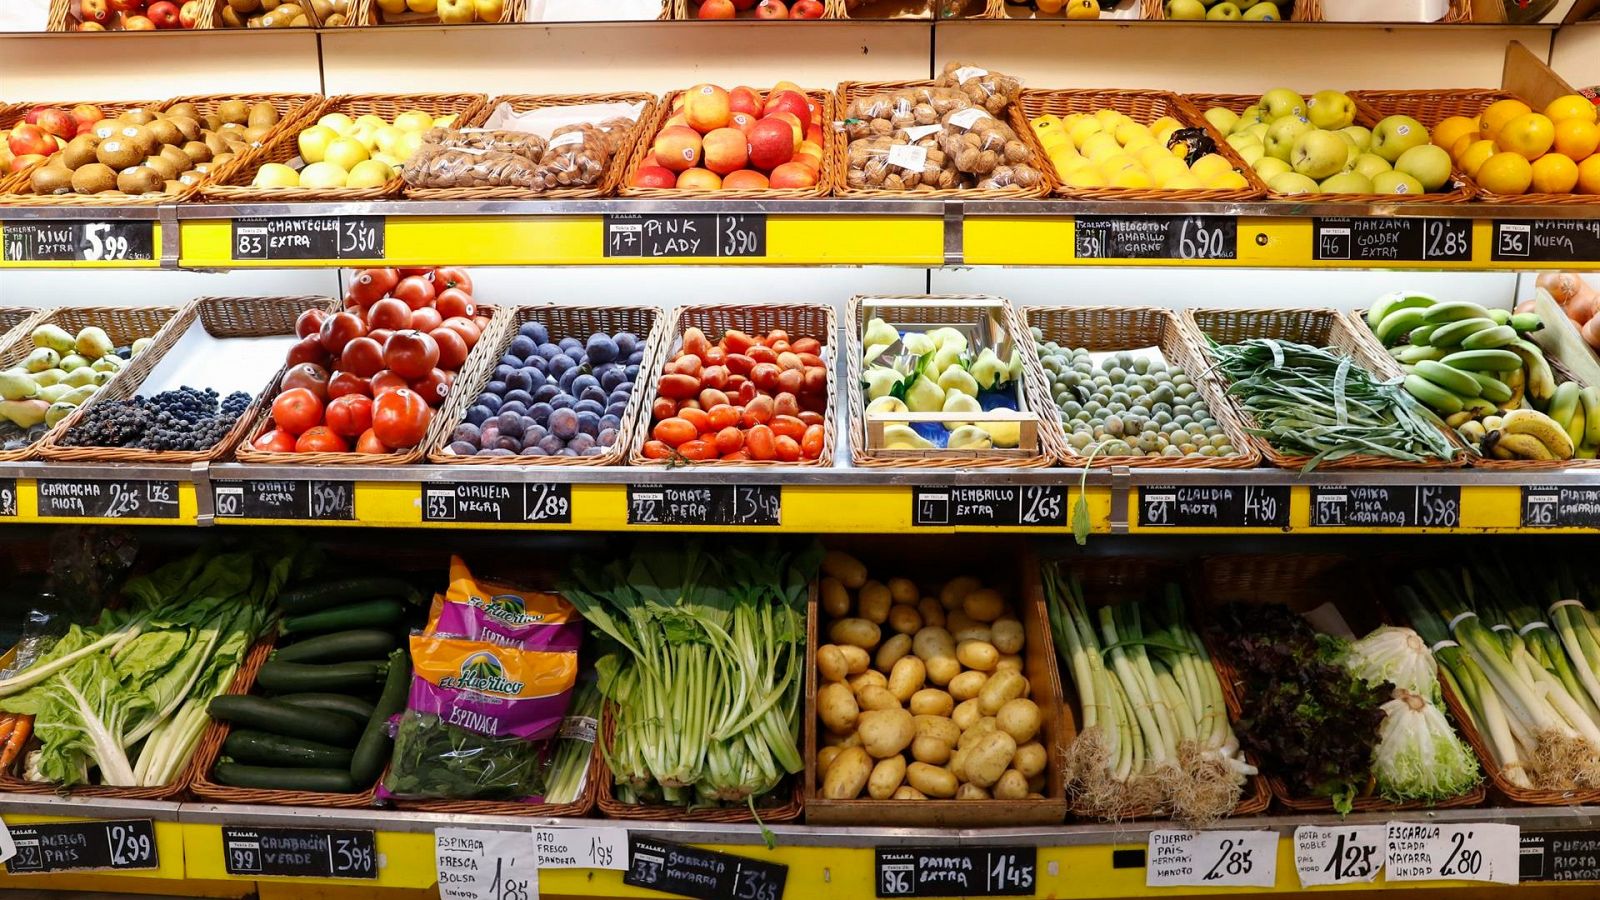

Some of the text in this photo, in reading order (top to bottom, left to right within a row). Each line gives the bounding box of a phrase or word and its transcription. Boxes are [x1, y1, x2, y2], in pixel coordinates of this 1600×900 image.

[1354, 219, 1411, 231] MANZANA
[38, 244, 74, 254] EXTRA
[239, 236, 262, 253] 83
[270, 235, 311, 248] EXTRA
[612, 232, 637, 250] 17
[653, 238, 700, 256] LADY
[1082, 237, 1099, 258] 39
[1322, 236, 1339, 255] 46
[1502, 233, 1523, 251] 36
[10, 241, 22, 260] 10
[1361, 247, 1399, 258] EXTRA
[153, 485, 169, 500] 76
[251, 481, 296, 492] TOMATE
[457, 485, 510, 499] CIRUELA
[1177, 488, 1232, 501] CLAUDIA
[259, 492, 293, 502] EXTRA
[666, 489, 711, 501] TOMATE
[952, 489, 1014, 501] MEMBRILLO
[219, 494, 237, 514] 60
[459, 500, 501, 521] NEGRA
[633, 500, 659, 522] 72
[923, 501, 933, 519] 4
[956, 504, 993, 519] EXTRA
[671, 504, 707, 521] PERA
[1320, 501, 1340, 524] 54
[1530, 504, 1553, 523] 16
[457, 669, 524, 695] Huertico
[448, 706, 499, 736] ESPINACA
[1154, 834, 1193, 845] PUERRO
[1300, 841, 1327, 850] ROBLE
[538, 844, 567, 853] FRESCO
[234, 850, 254, 868] 99
[265, 853, 311, 864] VERDE
[440, 857, 478, 871] FRESCA
[919, 857, 972, 870] PATATA
[1389, 853, 1432, 864] NAVARRA
[439, 872, 475, 884] BOLSA
[635, 861, 658, 883] 33
[666, 869, 717, 888] NAVARRA
[919, 871, 967, 888] EXTRA
[1396, 866, 1432, 877] UNIDAD
[885, 870, 909, 893] 96
